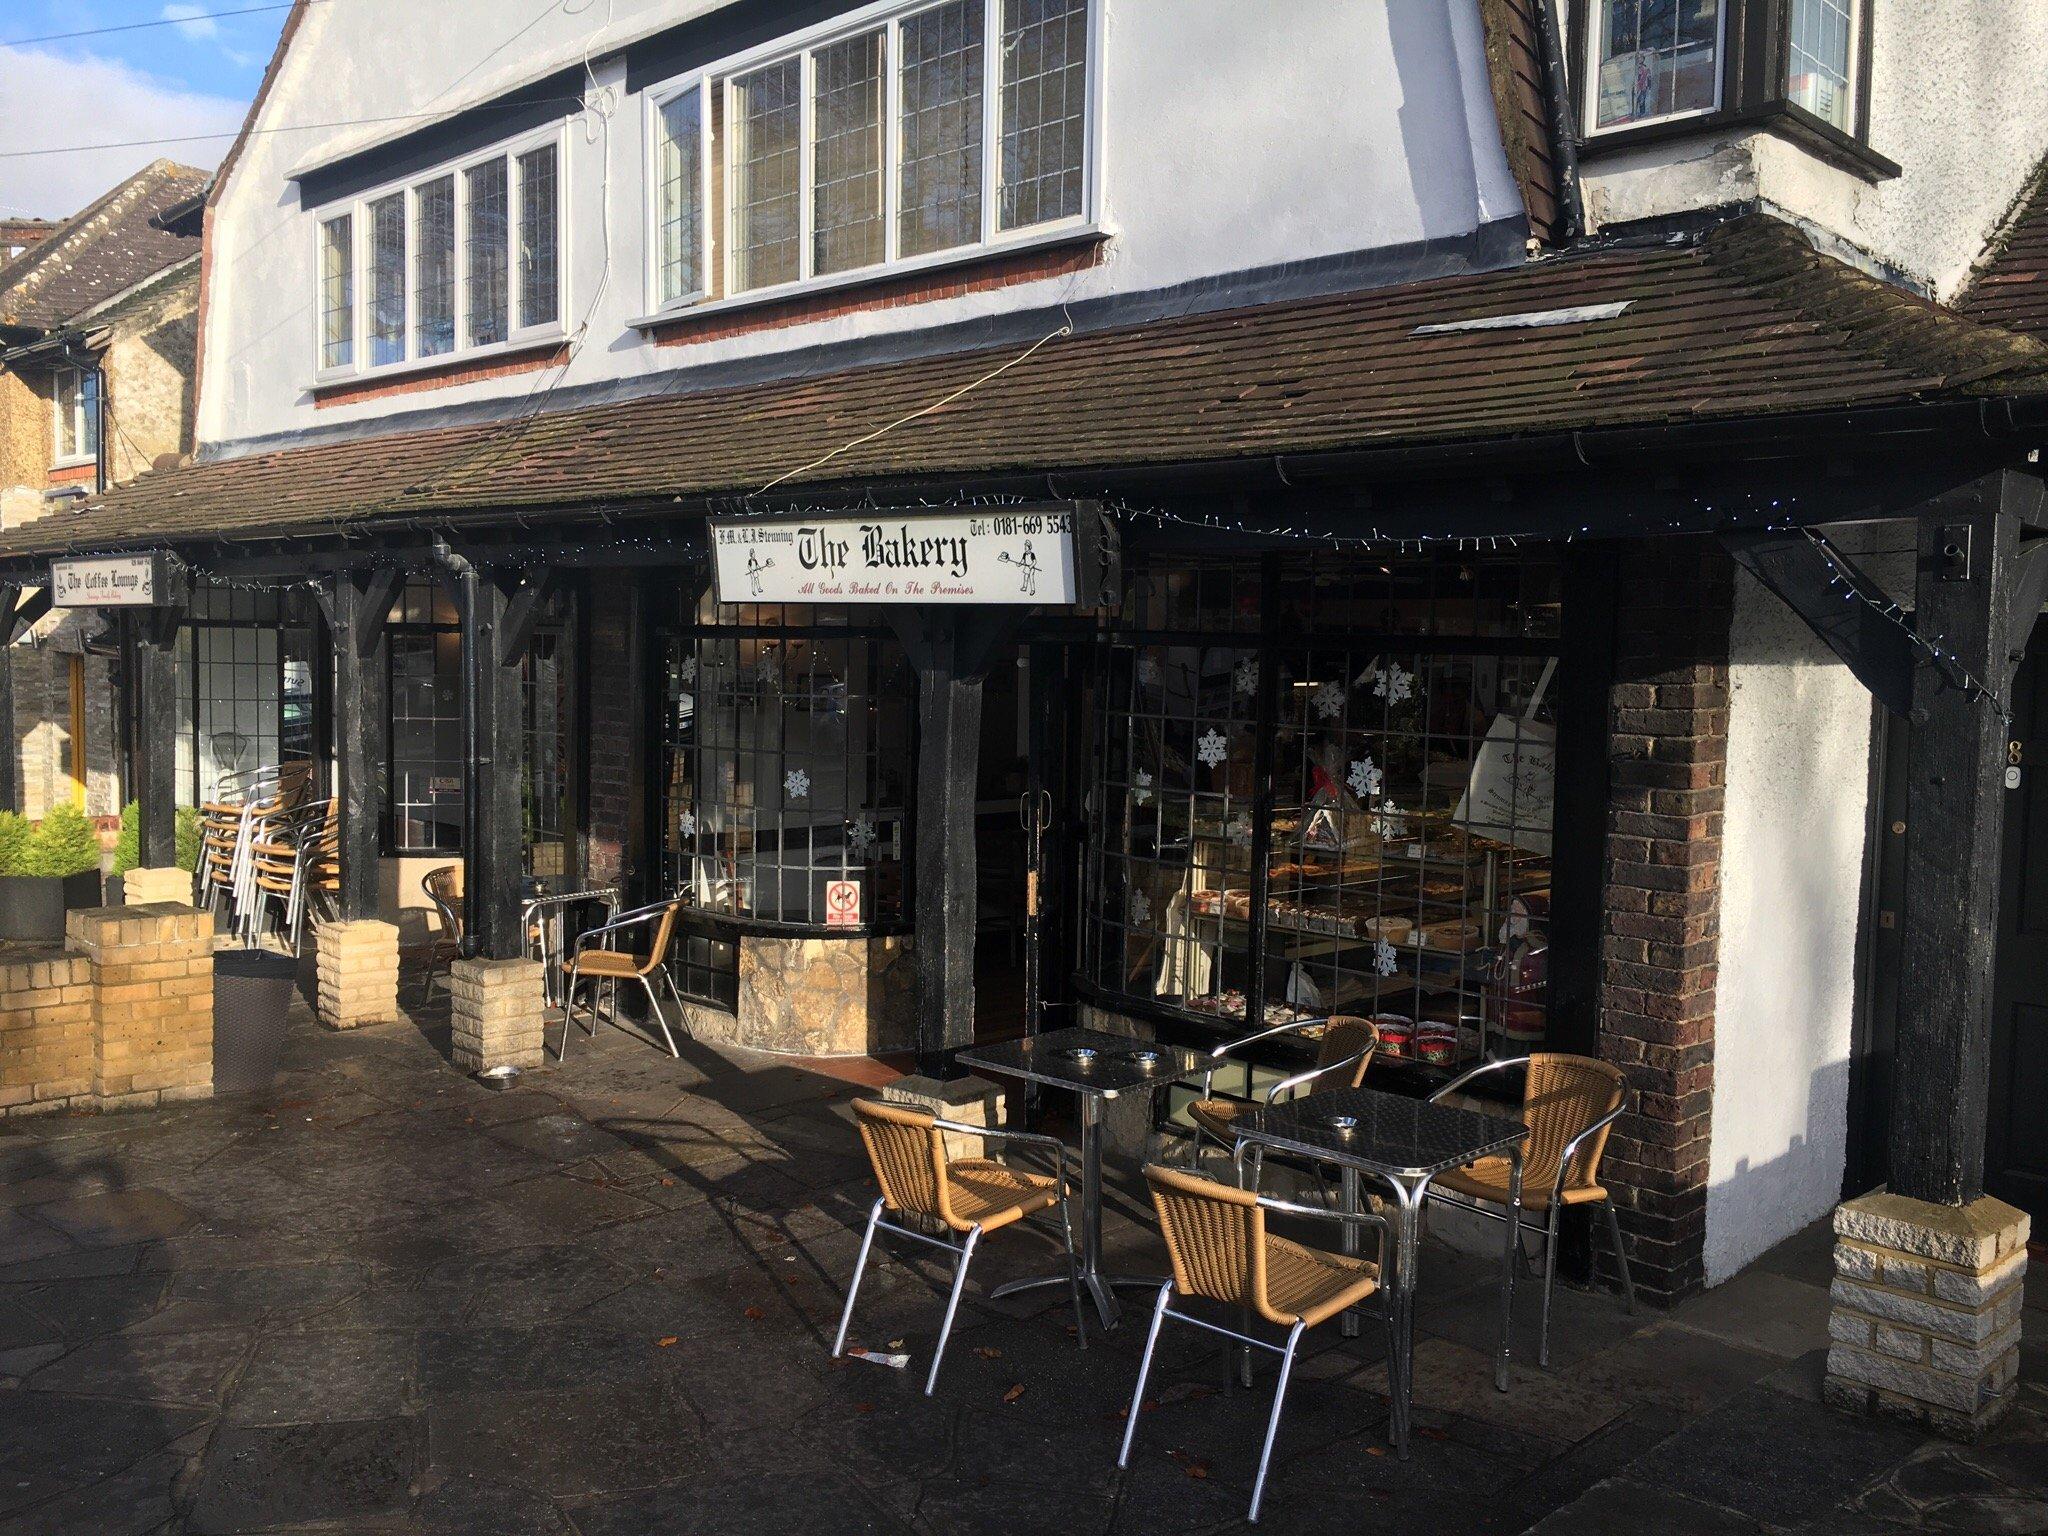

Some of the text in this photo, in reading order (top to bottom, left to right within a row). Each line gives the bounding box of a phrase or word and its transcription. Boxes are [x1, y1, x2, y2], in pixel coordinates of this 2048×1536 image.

[993, 515, 1043, 536] 0181-669
[758, 527, 794, 546] Stenning
[797, 524, 968, 579] The Bakery
[67, 569, 139, 591] The Coffee Lounge
[798, 581, 974, 595] All Goods Baked On The Premises
[2008, 741, 2022, 764] 8
